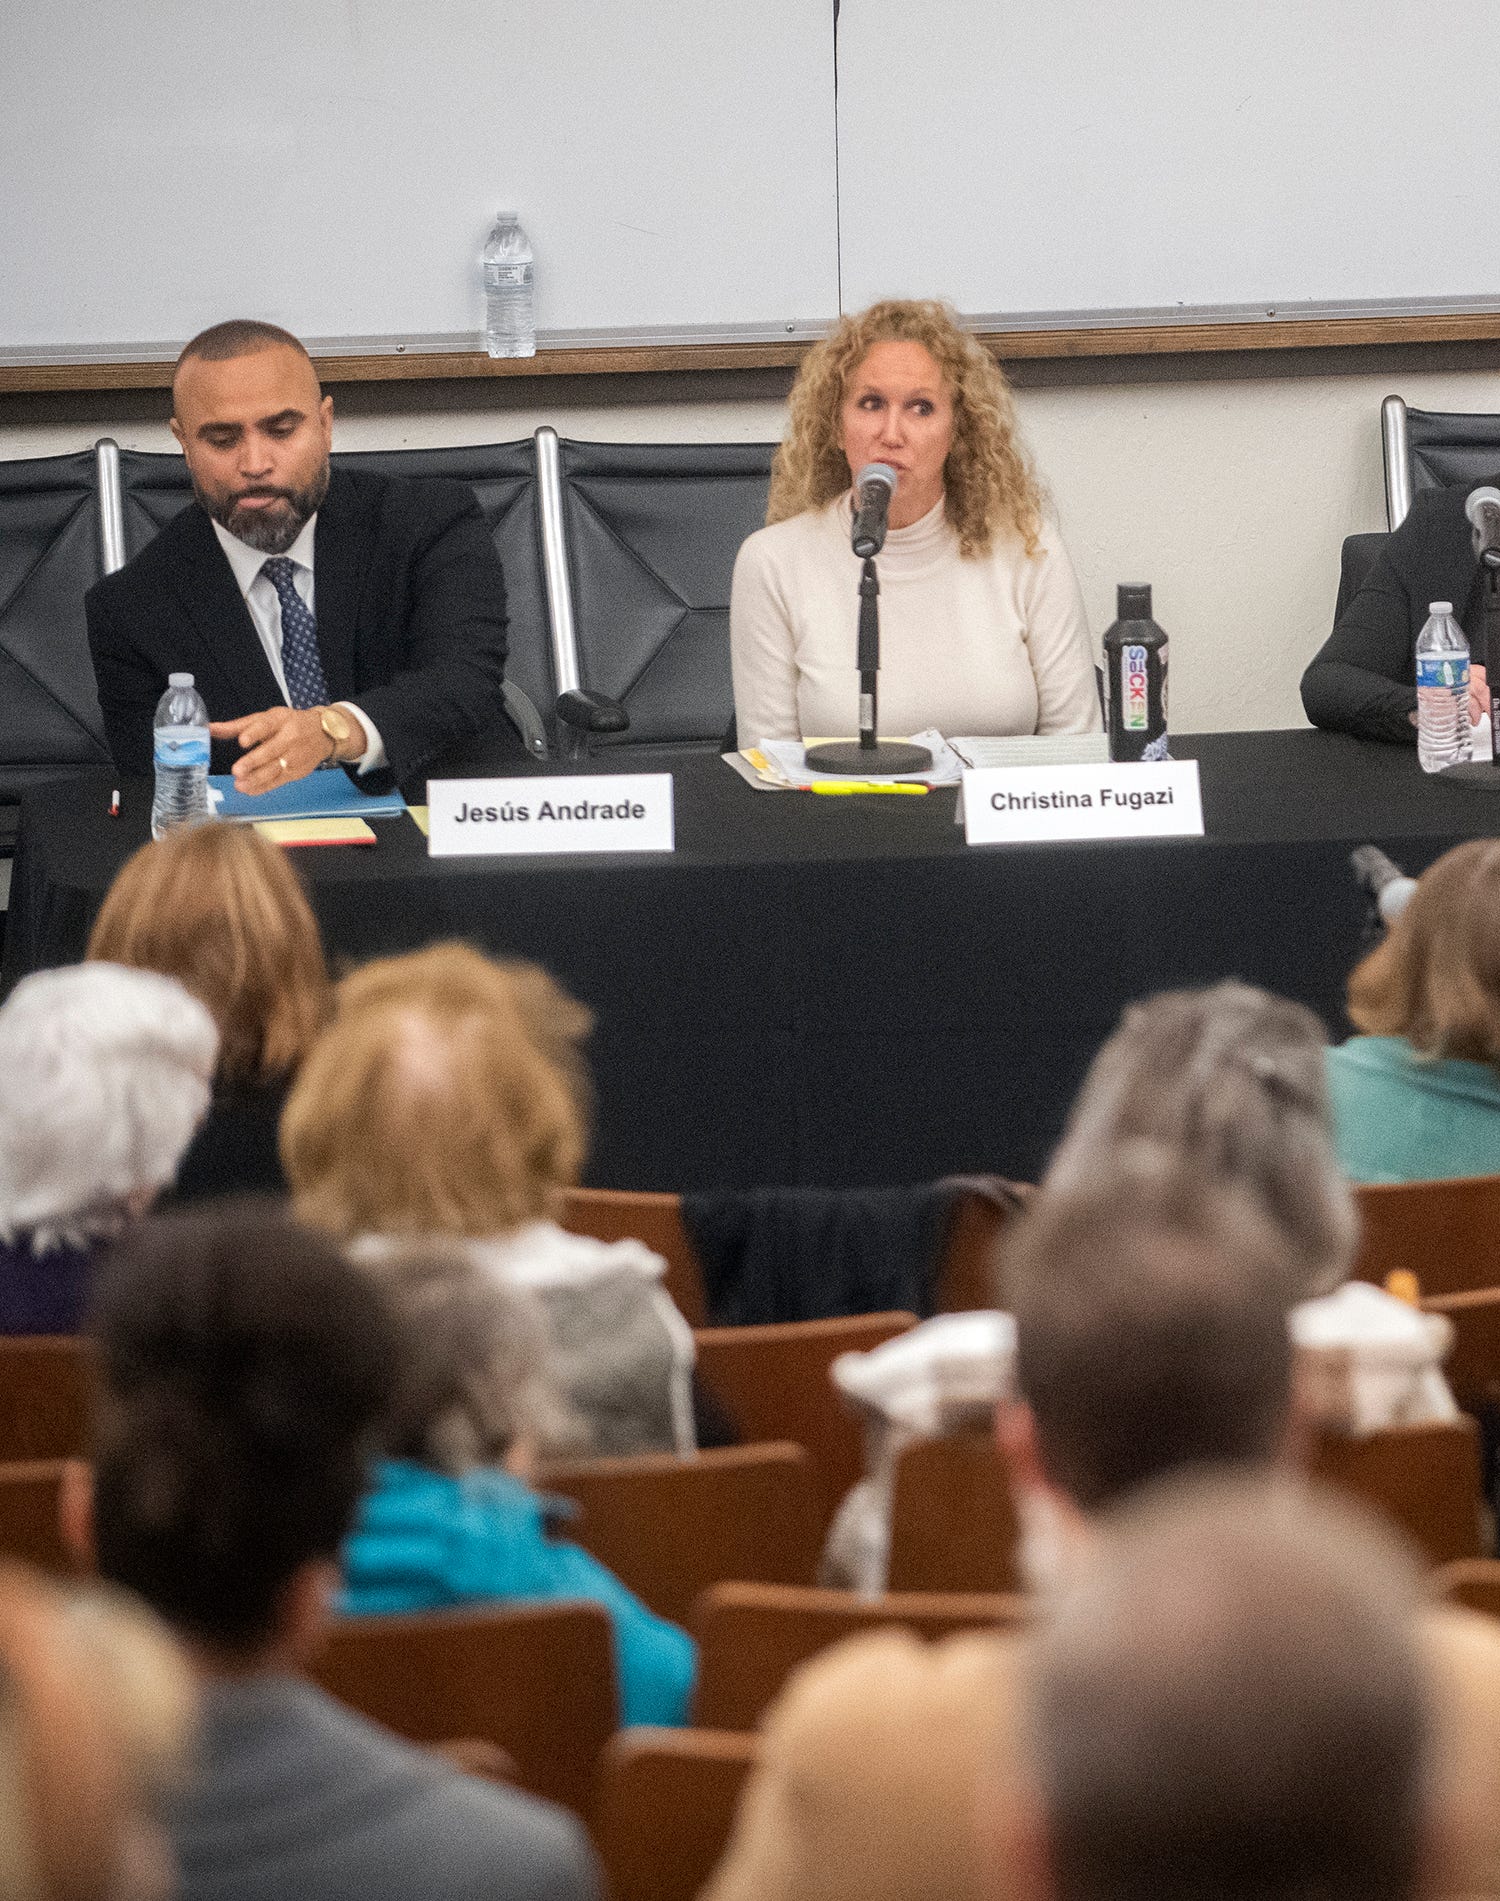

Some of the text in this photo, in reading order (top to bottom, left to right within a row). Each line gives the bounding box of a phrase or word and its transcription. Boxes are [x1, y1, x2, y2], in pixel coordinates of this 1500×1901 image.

[990, 786, 1174, 811] Christina Fugazi
[454, 799, 646, 823] Jesús Andrade
